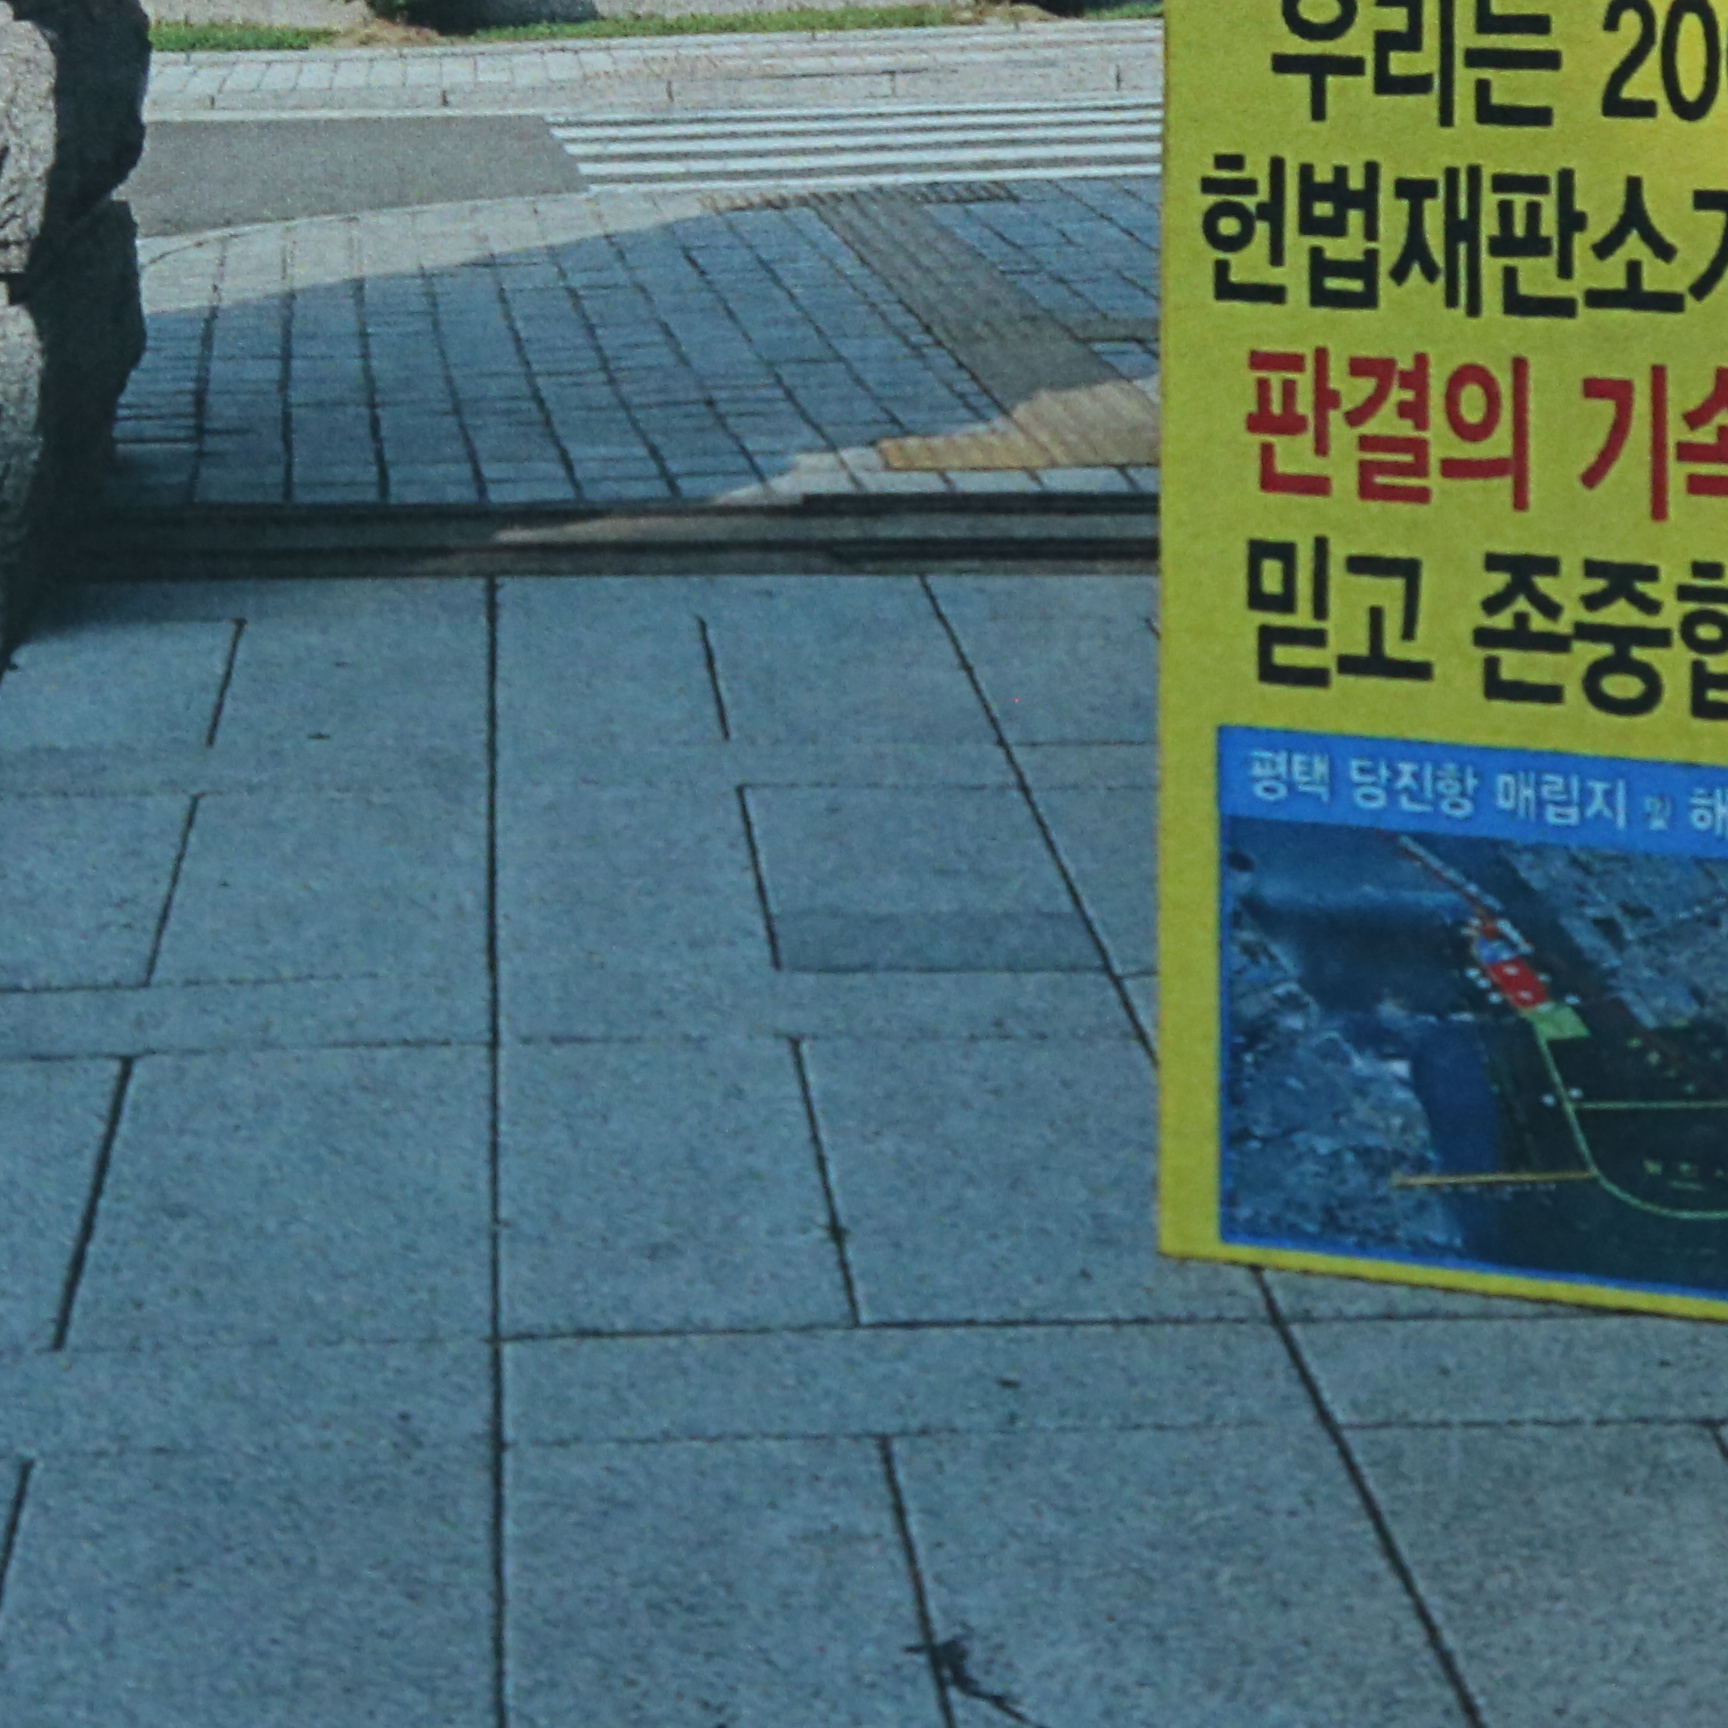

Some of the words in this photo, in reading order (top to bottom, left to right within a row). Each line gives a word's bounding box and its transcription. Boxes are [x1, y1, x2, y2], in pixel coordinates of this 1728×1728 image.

[1246, 347, 1529, 512] 판결의
[1246, 535, 1434, 689] 믿고
[1250, 749, 1331, 804] 평택
[1349, 757, 1479, 819] 당진항
